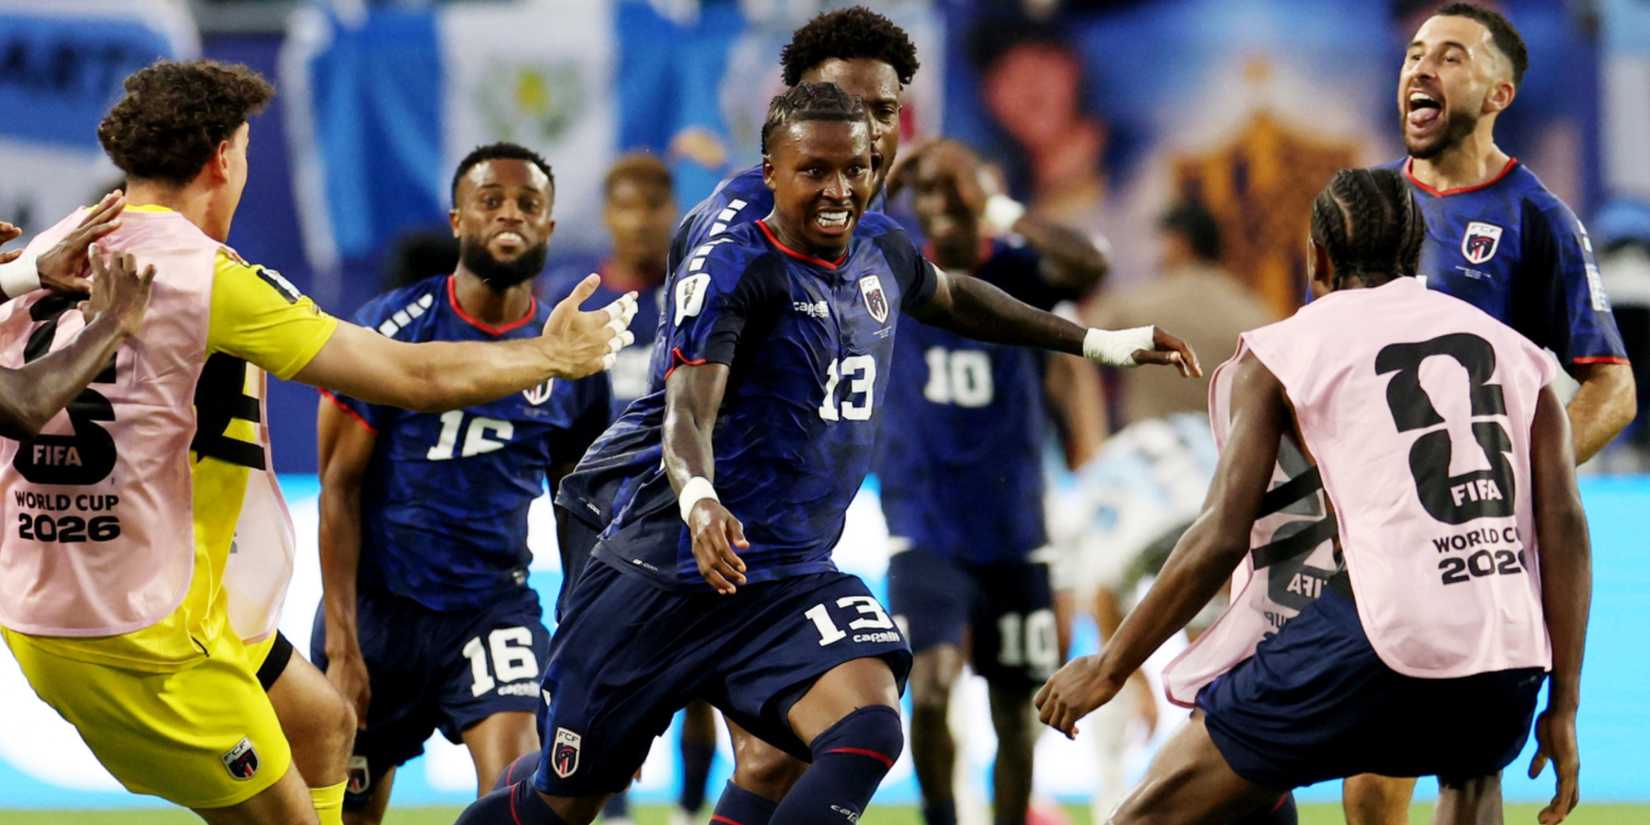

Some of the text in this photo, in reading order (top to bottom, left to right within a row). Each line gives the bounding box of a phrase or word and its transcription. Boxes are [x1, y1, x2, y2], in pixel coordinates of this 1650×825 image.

[818, 354, 876, 421] 13
[923, 346, 994, 407] 10
[32, 444, 83, 467] FIFA
[15, 490, 119, 511] WORLD CUP
[1450, 478, 1503, 507] FIFA
[18, 513, 121, 543] 2026
[1432, 527, 1499, 553] WORLD
[804, 595, 894, 646] 13
[997, 609, 1060, 667] 10
[462, 626, 539, 697] 16
[559, 731, 579, 742] FCF
